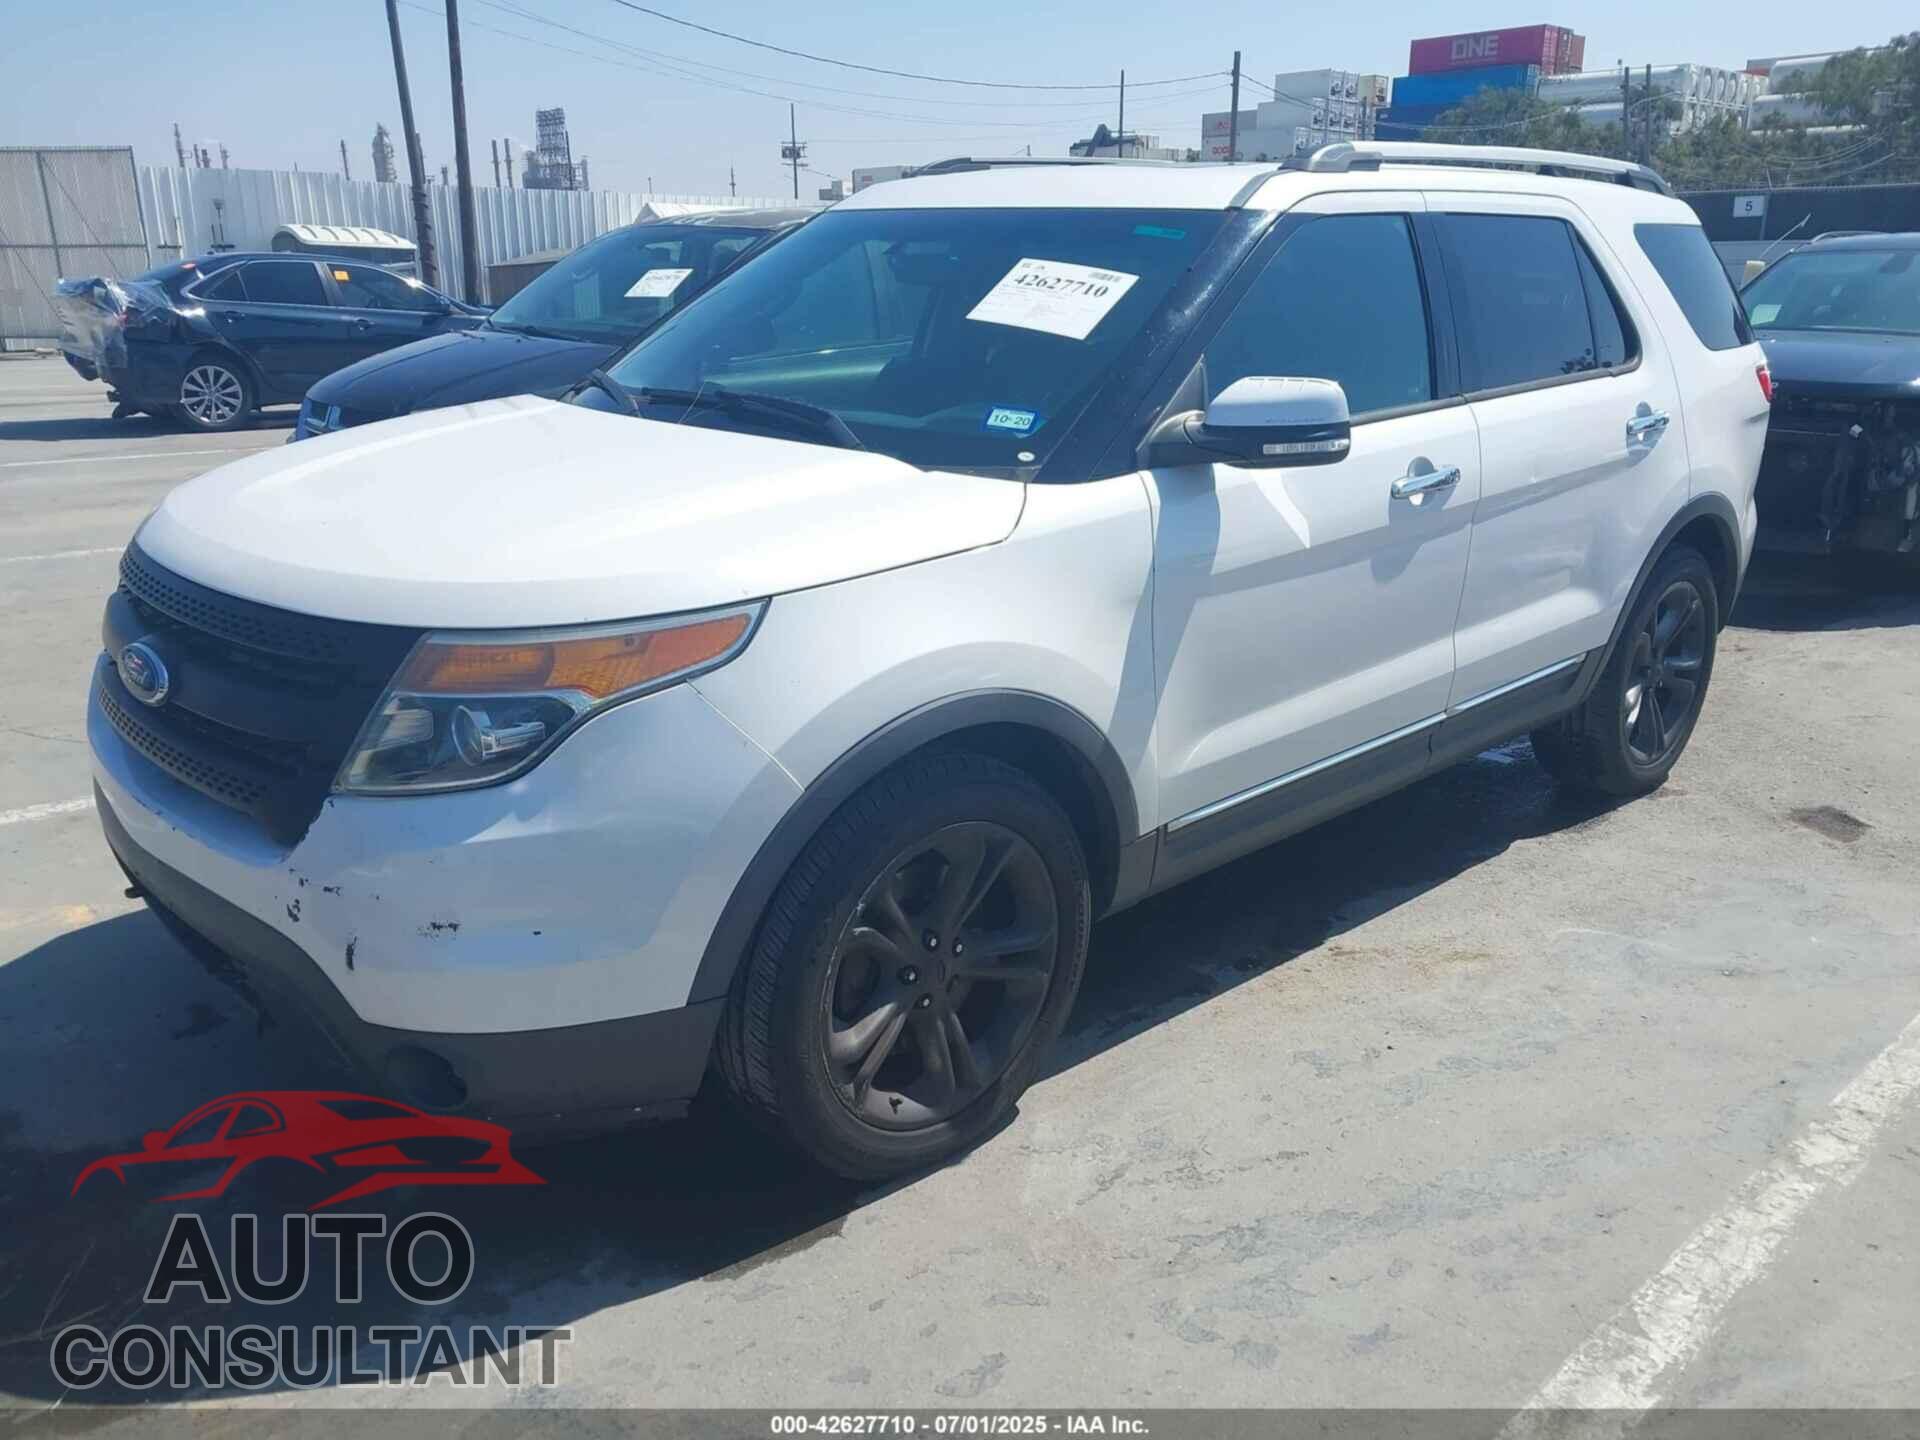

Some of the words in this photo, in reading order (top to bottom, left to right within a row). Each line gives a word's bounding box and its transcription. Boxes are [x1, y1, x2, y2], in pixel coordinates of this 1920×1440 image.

[1451, 35, 1498, 59] ONE
[1745, 200, 1753, 211] 5
[1014, 273, 1109, 298] 42627710
